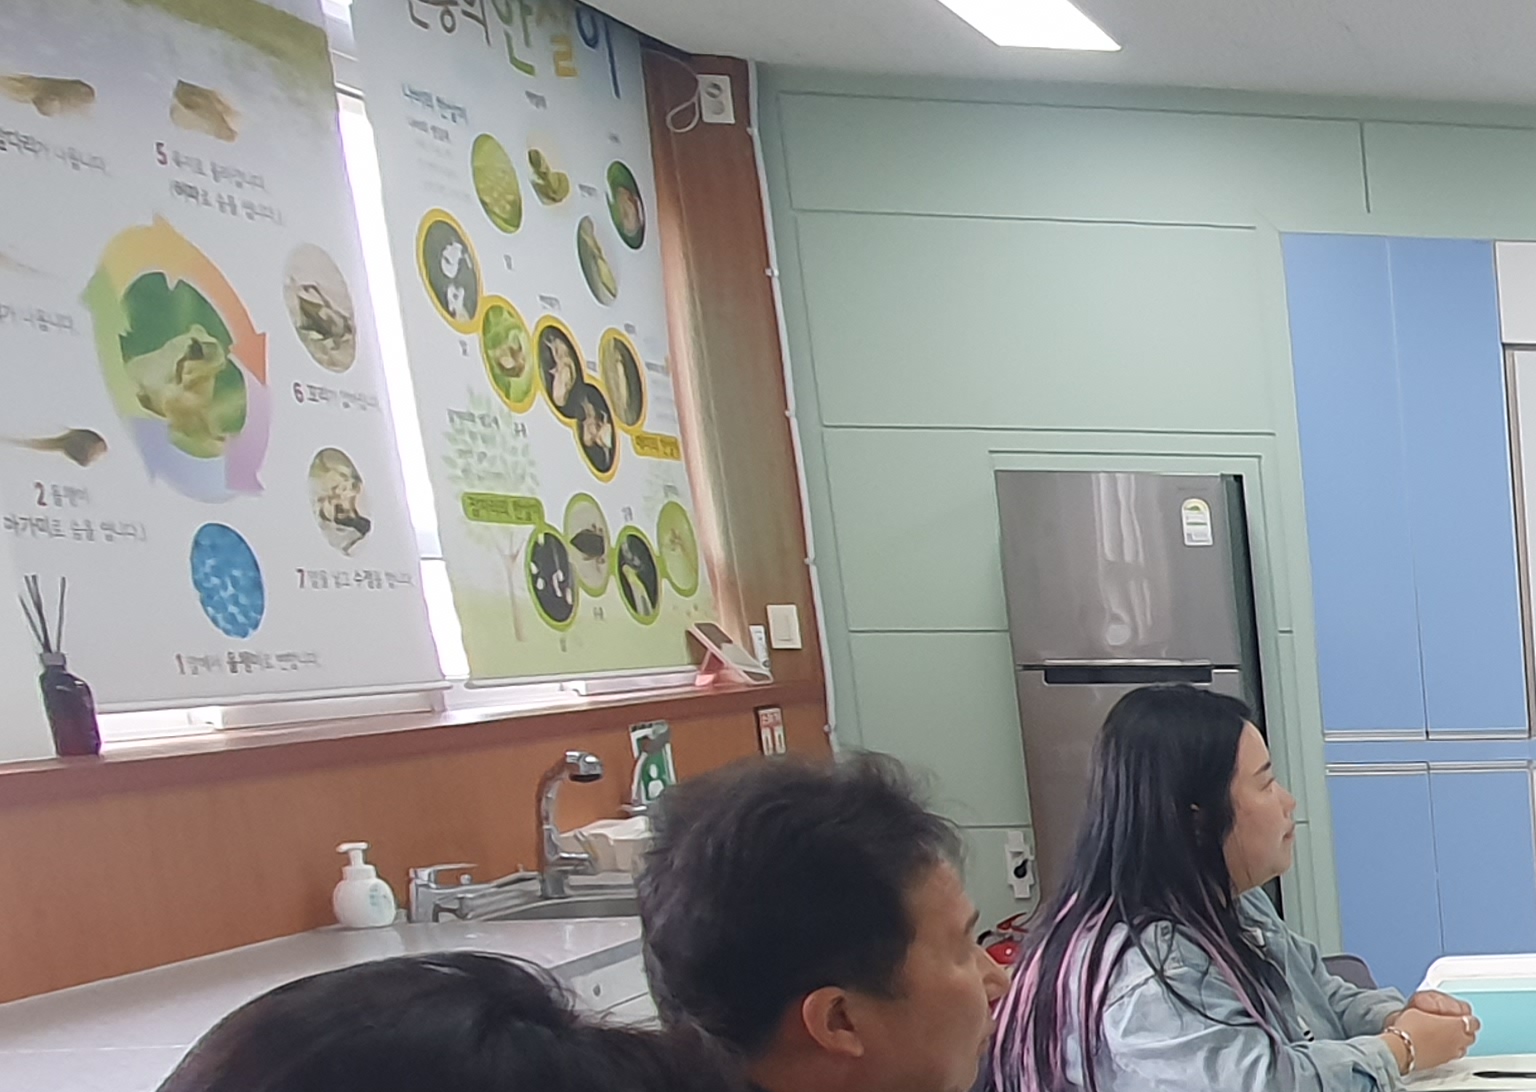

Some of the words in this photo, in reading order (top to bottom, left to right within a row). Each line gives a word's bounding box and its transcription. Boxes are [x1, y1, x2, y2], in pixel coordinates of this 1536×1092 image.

[155, 142, 168, 166] 5
[293, 382, 304, 403] 6
[34, 482, 48, 507] 2
[296, 567, 305, 589] 7
[175, 652, 187, 675] 1
